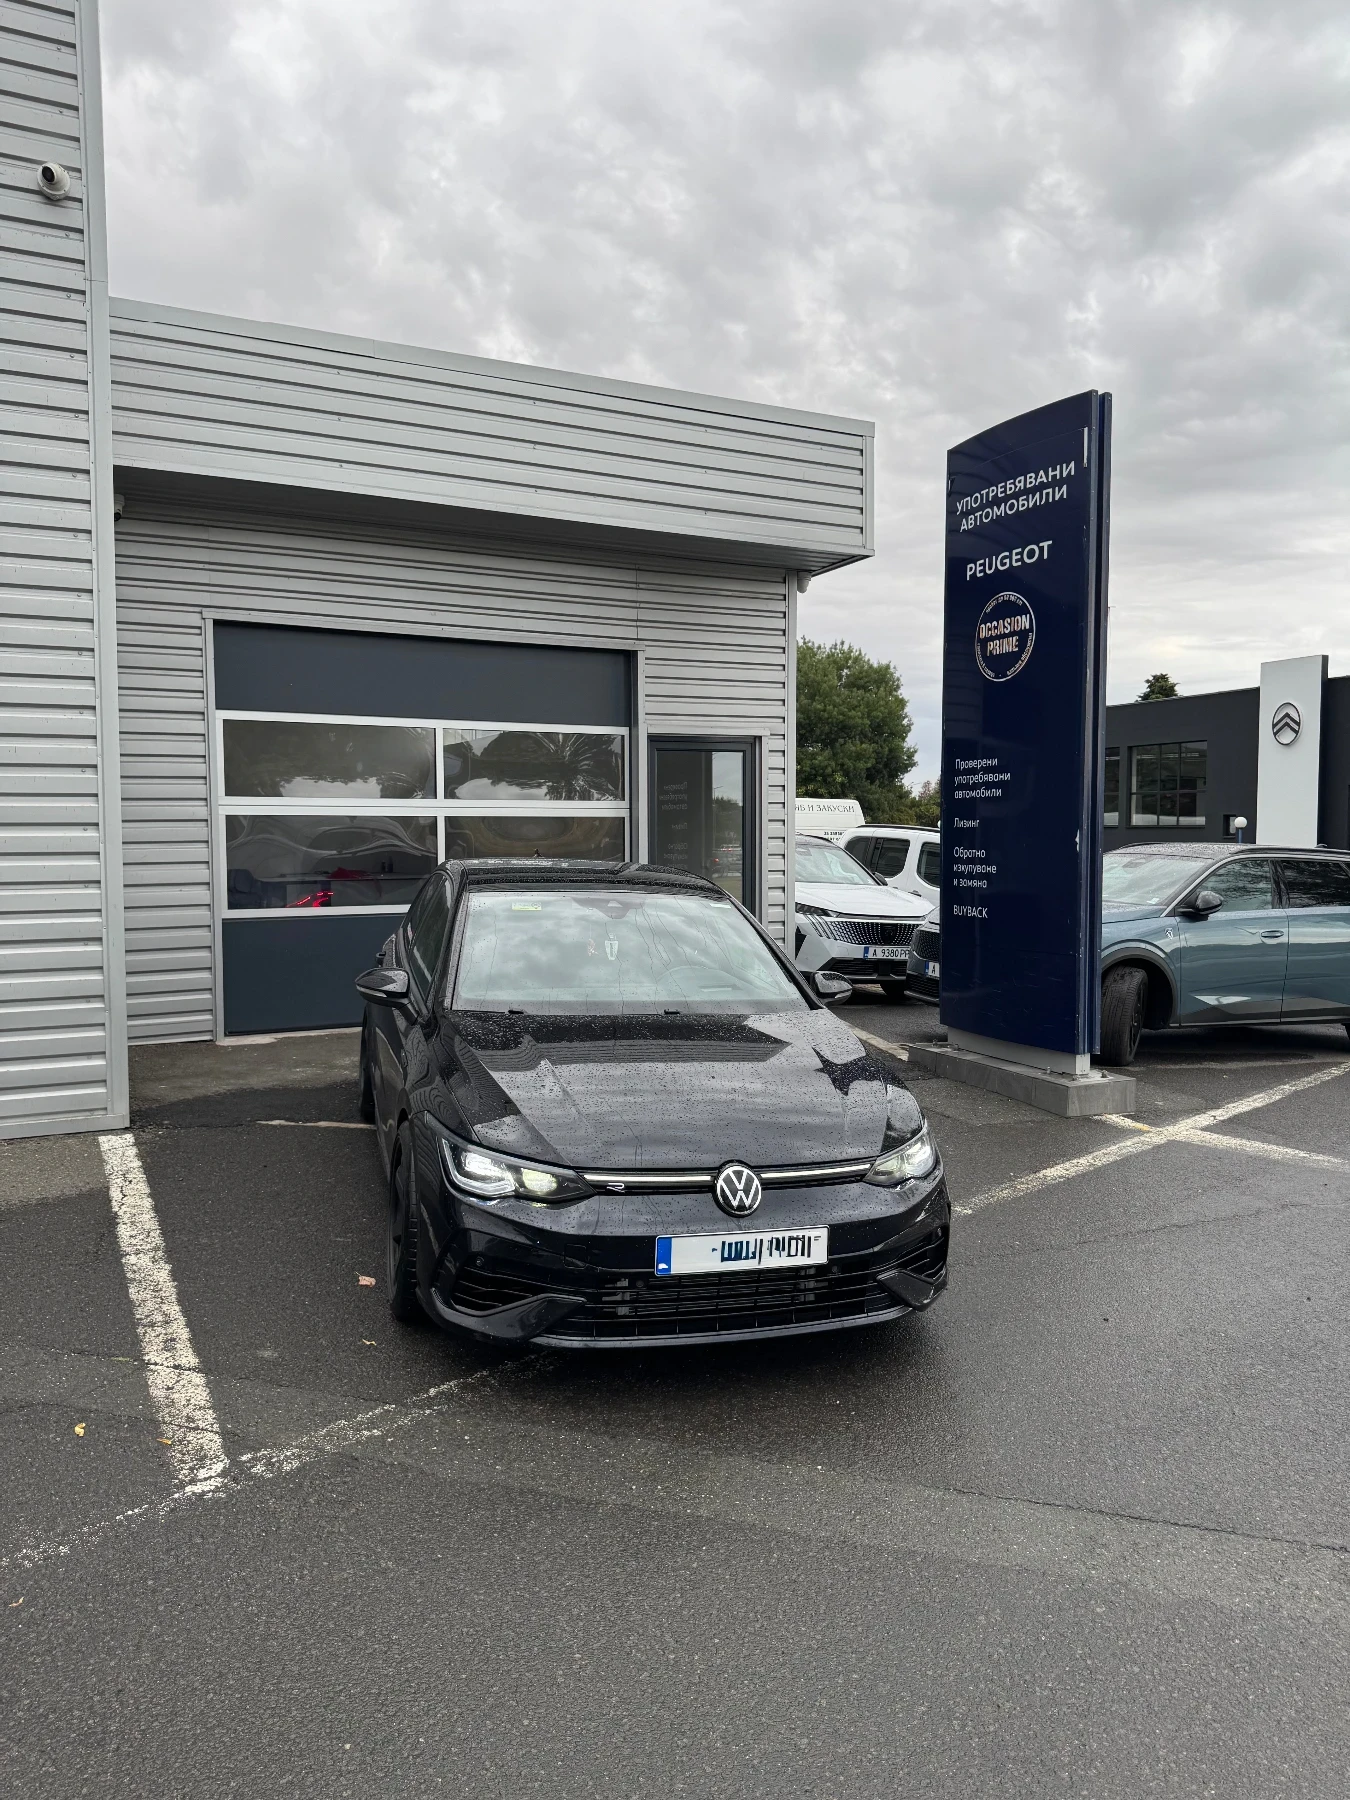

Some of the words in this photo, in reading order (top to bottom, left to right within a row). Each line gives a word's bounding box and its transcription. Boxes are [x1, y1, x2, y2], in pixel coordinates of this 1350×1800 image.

[956, 460, 1075, 515] УПОТРЕБЯВАНИ
[960, 484, 1067, 532] АВТОМОБИЛИ
[966, 540, 1053, 581] PEUGEOT
[979, 613, 1030, 639] OCCASION
[987, 635, 1019, 656] PRIME
[955, 757, 998, 771] Проверени
[954, 771, 1011, 787] употребявани
[954, 786, 1002, 799] автомобили
[807, 804, 814, 812] И
[816, 804, 855, 813] ЗАКУСКИ
[953, 817, 980, 828] Лизинг
[953, 846, 986, 860] Обратно
[953, 864, 997, 875] изкупуване
[953, 878, 958, 887] и
[959, 878, 988, 888] замяна
[953, 904, 988, 919] BUYBACK
